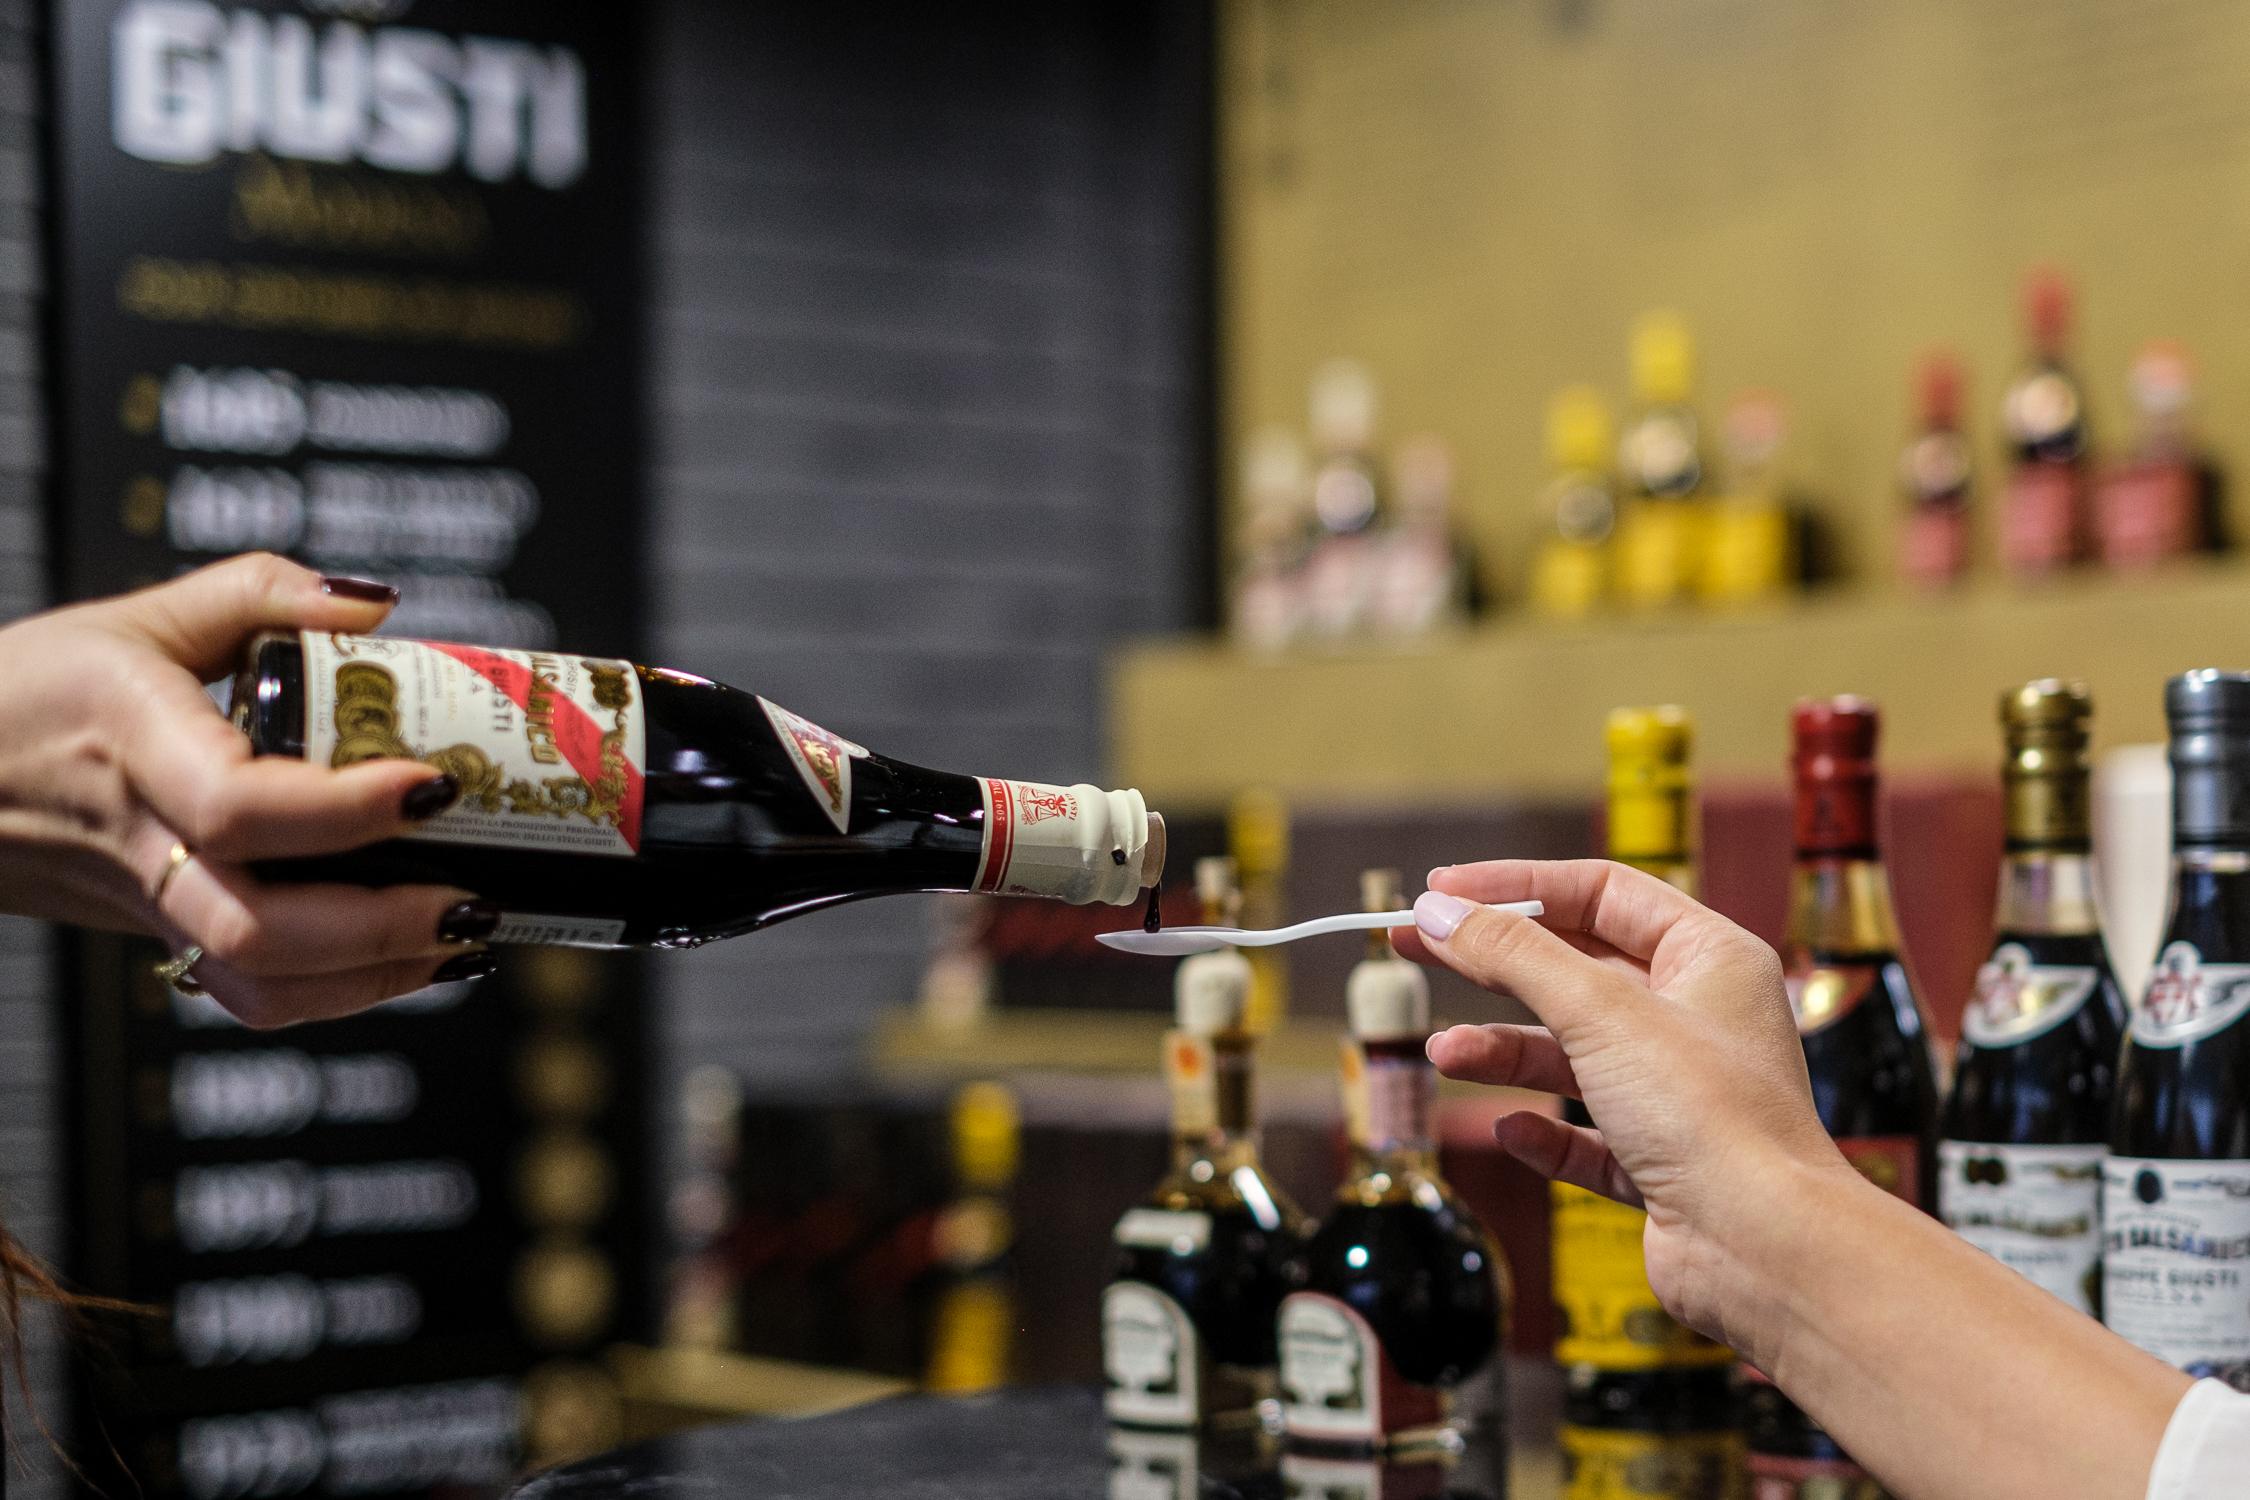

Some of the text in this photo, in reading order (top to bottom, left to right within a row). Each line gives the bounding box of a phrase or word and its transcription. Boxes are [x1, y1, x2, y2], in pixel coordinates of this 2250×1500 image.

[113, 4, 588, 190] GIUSTI
[489, 665, 514, 733] GIUSTI
[994, 800, 1005, 821] 1605
